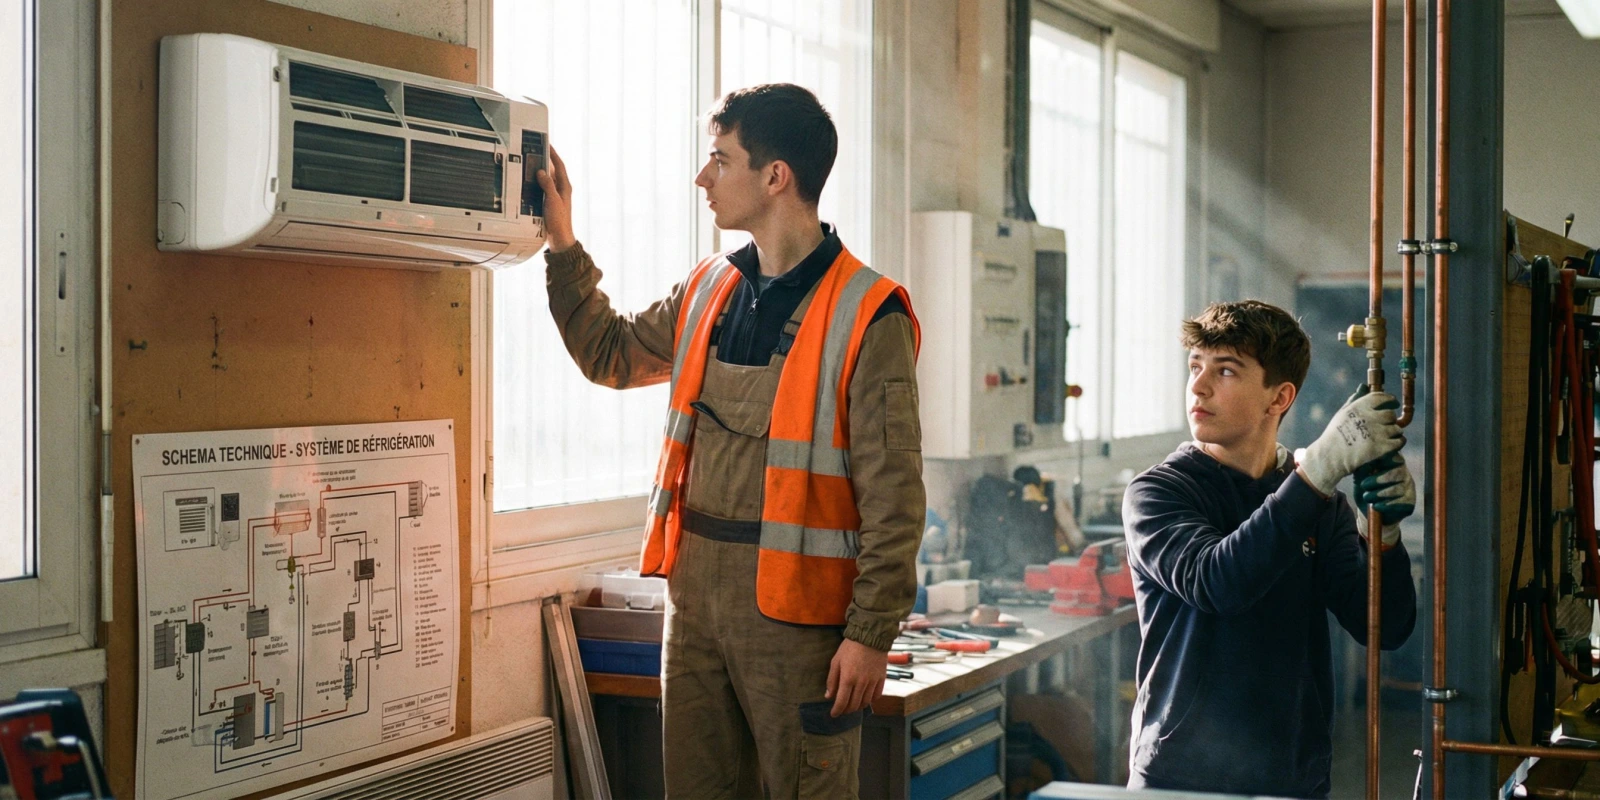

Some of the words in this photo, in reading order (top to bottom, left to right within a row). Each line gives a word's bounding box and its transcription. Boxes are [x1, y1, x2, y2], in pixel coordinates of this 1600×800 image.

[162, 448, 216, 466] SCHEMA
[219, 444, 286, 462] TECHNIQUE
[296, 437, 344, 457] SYSTÈME
[346, 439, 360, 453] DE
[362, 432, 435, 453] RÉFRIGÉRATION
